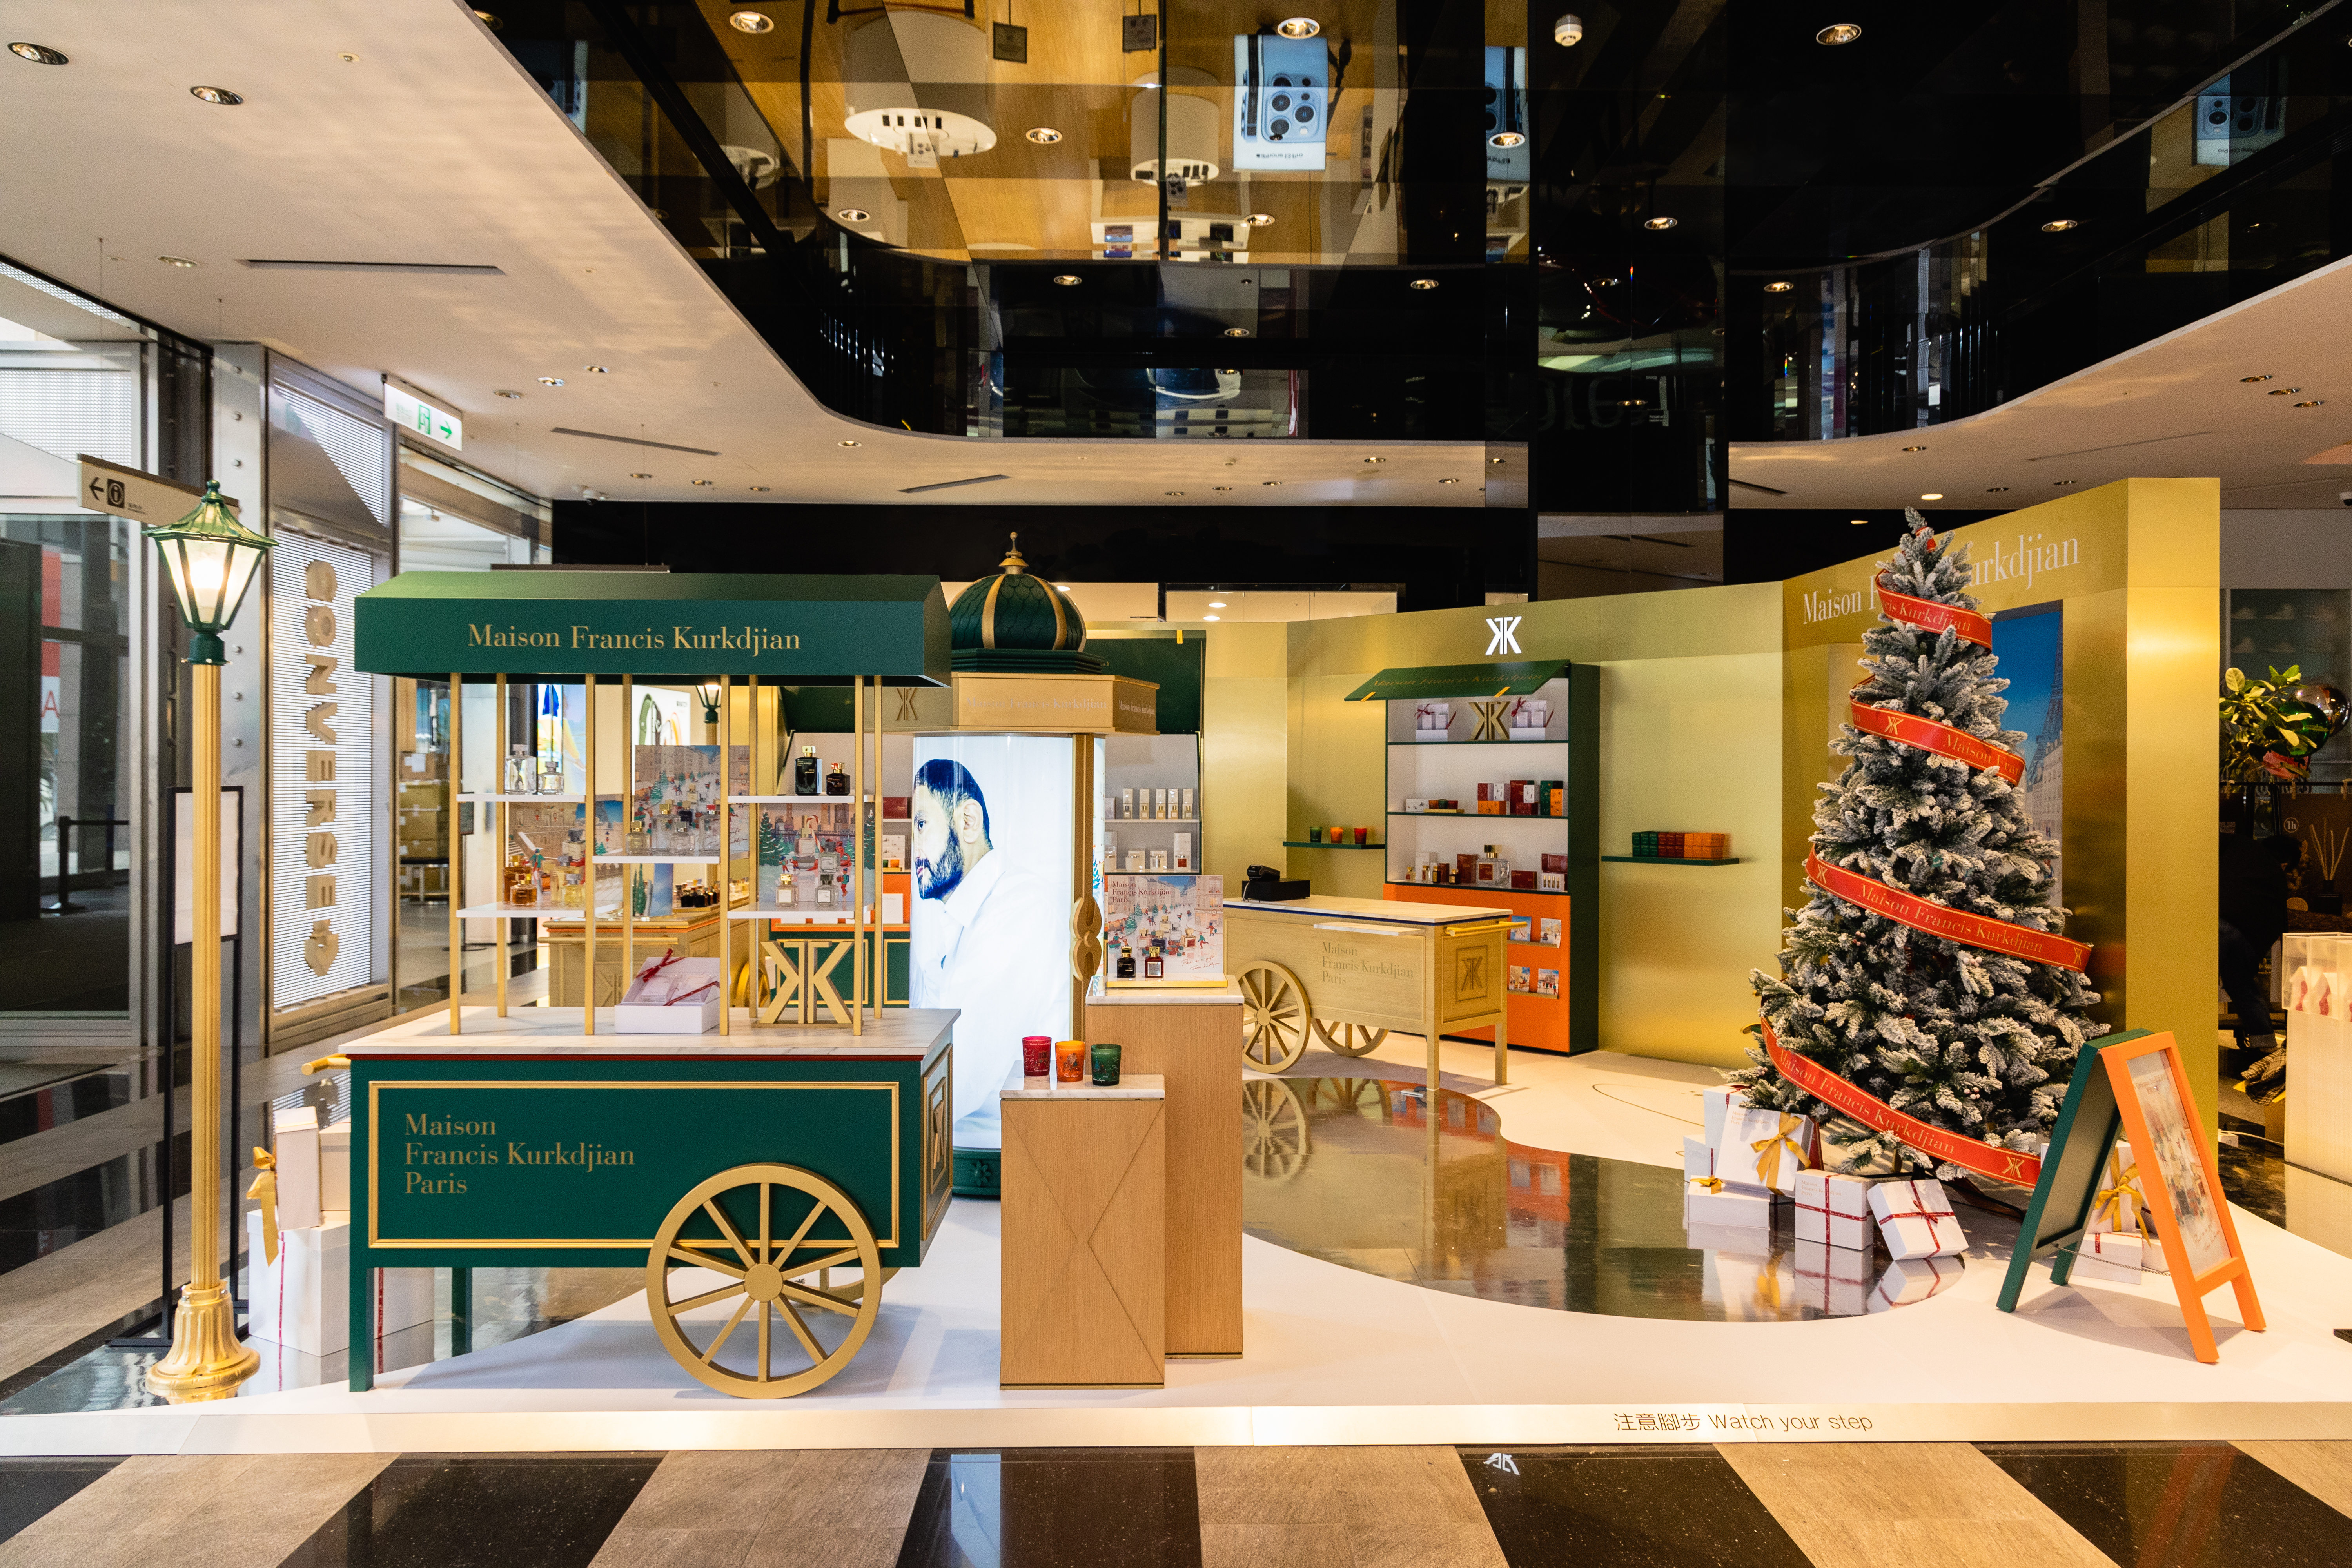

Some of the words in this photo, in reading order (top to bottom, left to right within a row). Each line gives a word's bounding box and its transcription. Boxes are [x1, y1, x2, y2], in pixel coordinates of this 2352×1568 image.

[1803, 589, 1862, 624] Maison
[468, 624, 561, 647] Maison
[570, 626, 664, 649] Francis
[672, 626, 801, 657] Kurkdjian
[967, 697, 1005, 708] Maison
[1011, 698, 1049, 709] Francis
[1054, 698, 1107, 711] Kurkdjian
[1943, 734, 1992, 764] Maison
[1858, 885, 1909, 915] Maison
[1915, 906, 1971, 935] Francis
[1976, 923, 2043, 953] Kurkdjian
[1322, 942, 1357, 956] Maison
[1322, 956, 1359, 971] Francis
[1362, 960, 1414, 979] Kurkdjian
[1322, 971, 1347, 984] Paris
[1779, 1049, 1816, 1084] Maison
[1819, 1076, 1870, 1116] Francis
[1874, 1109, 1955, 1155] Kurkdjian
[405, 1113, 497, 1136] Maison
[405, 1142, 499, 1165] Francis
[507, 1142, 636, 1173] Kurkdjian
[405, 1171, 468, 1194] Paris
[1614, 1413, 1700, 1431] 注意腳步
[1708, 1414, 1774, 1430] Watch
[1779, 1417, 1820, 1432] your
[1828, 1414, 1873, 1432] step
